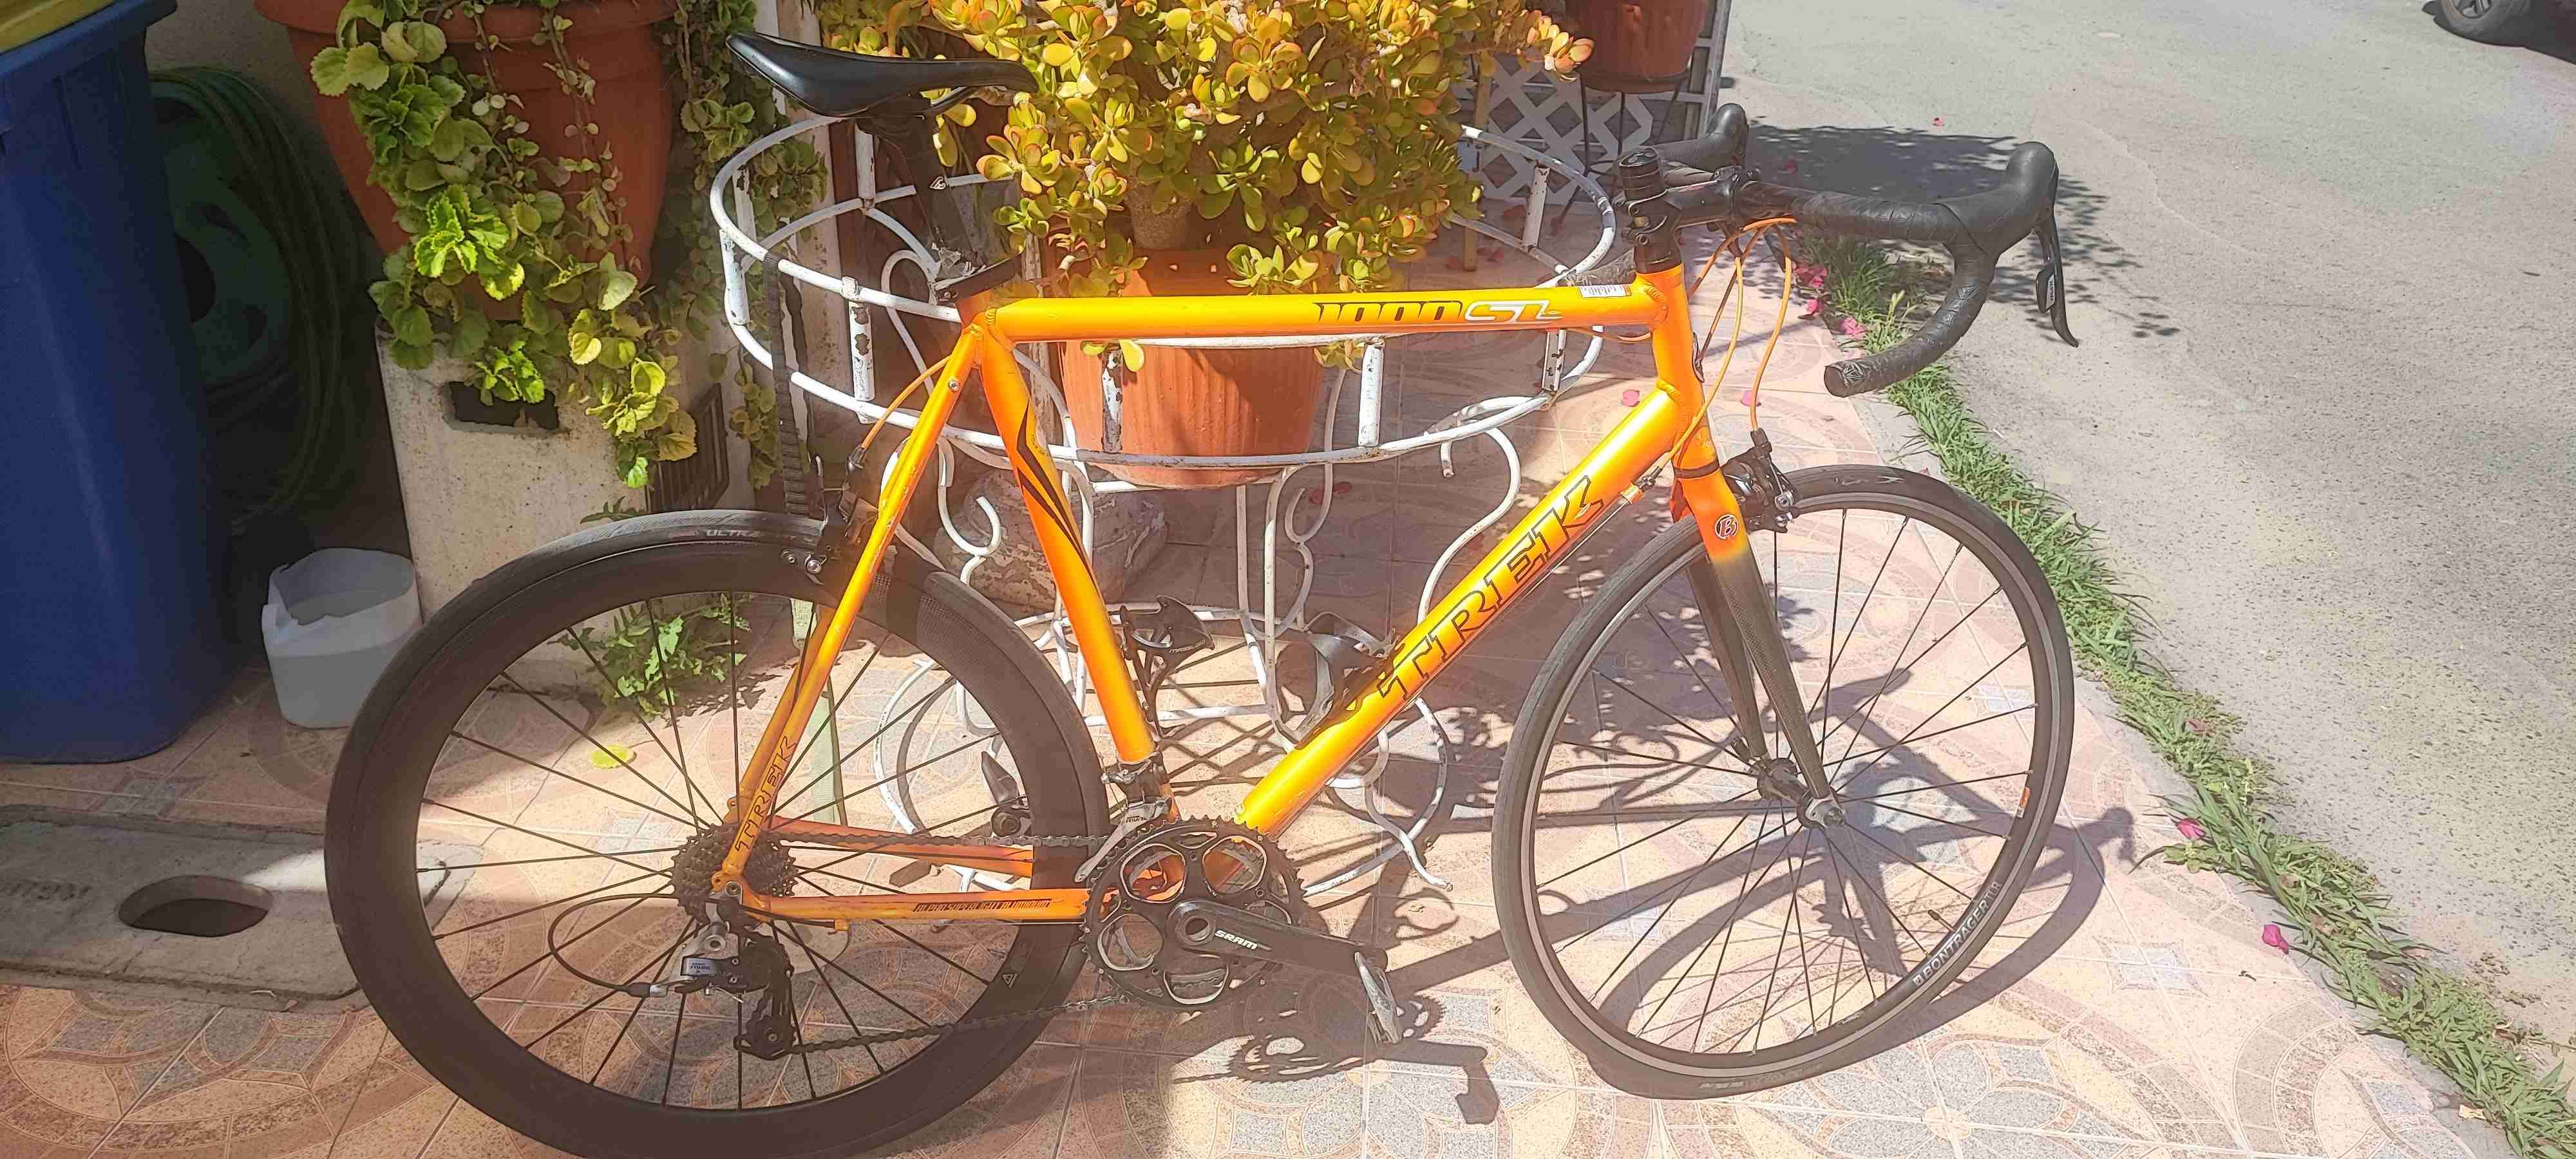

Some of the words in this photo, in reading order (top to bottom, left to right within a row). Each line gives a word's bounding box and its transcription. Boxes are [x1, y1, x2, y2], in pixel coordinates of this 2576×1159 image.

[1312, 300, 1463, 322] 1000
[1464, 299, 1563, 323] SL
[1376, 475, 1604, 701] TREK
[734, 735, 797, 852] TREK
[1214, 929, 1258, 950] SRAM
[1922, 899, 1989, 979] BONTRAGER
